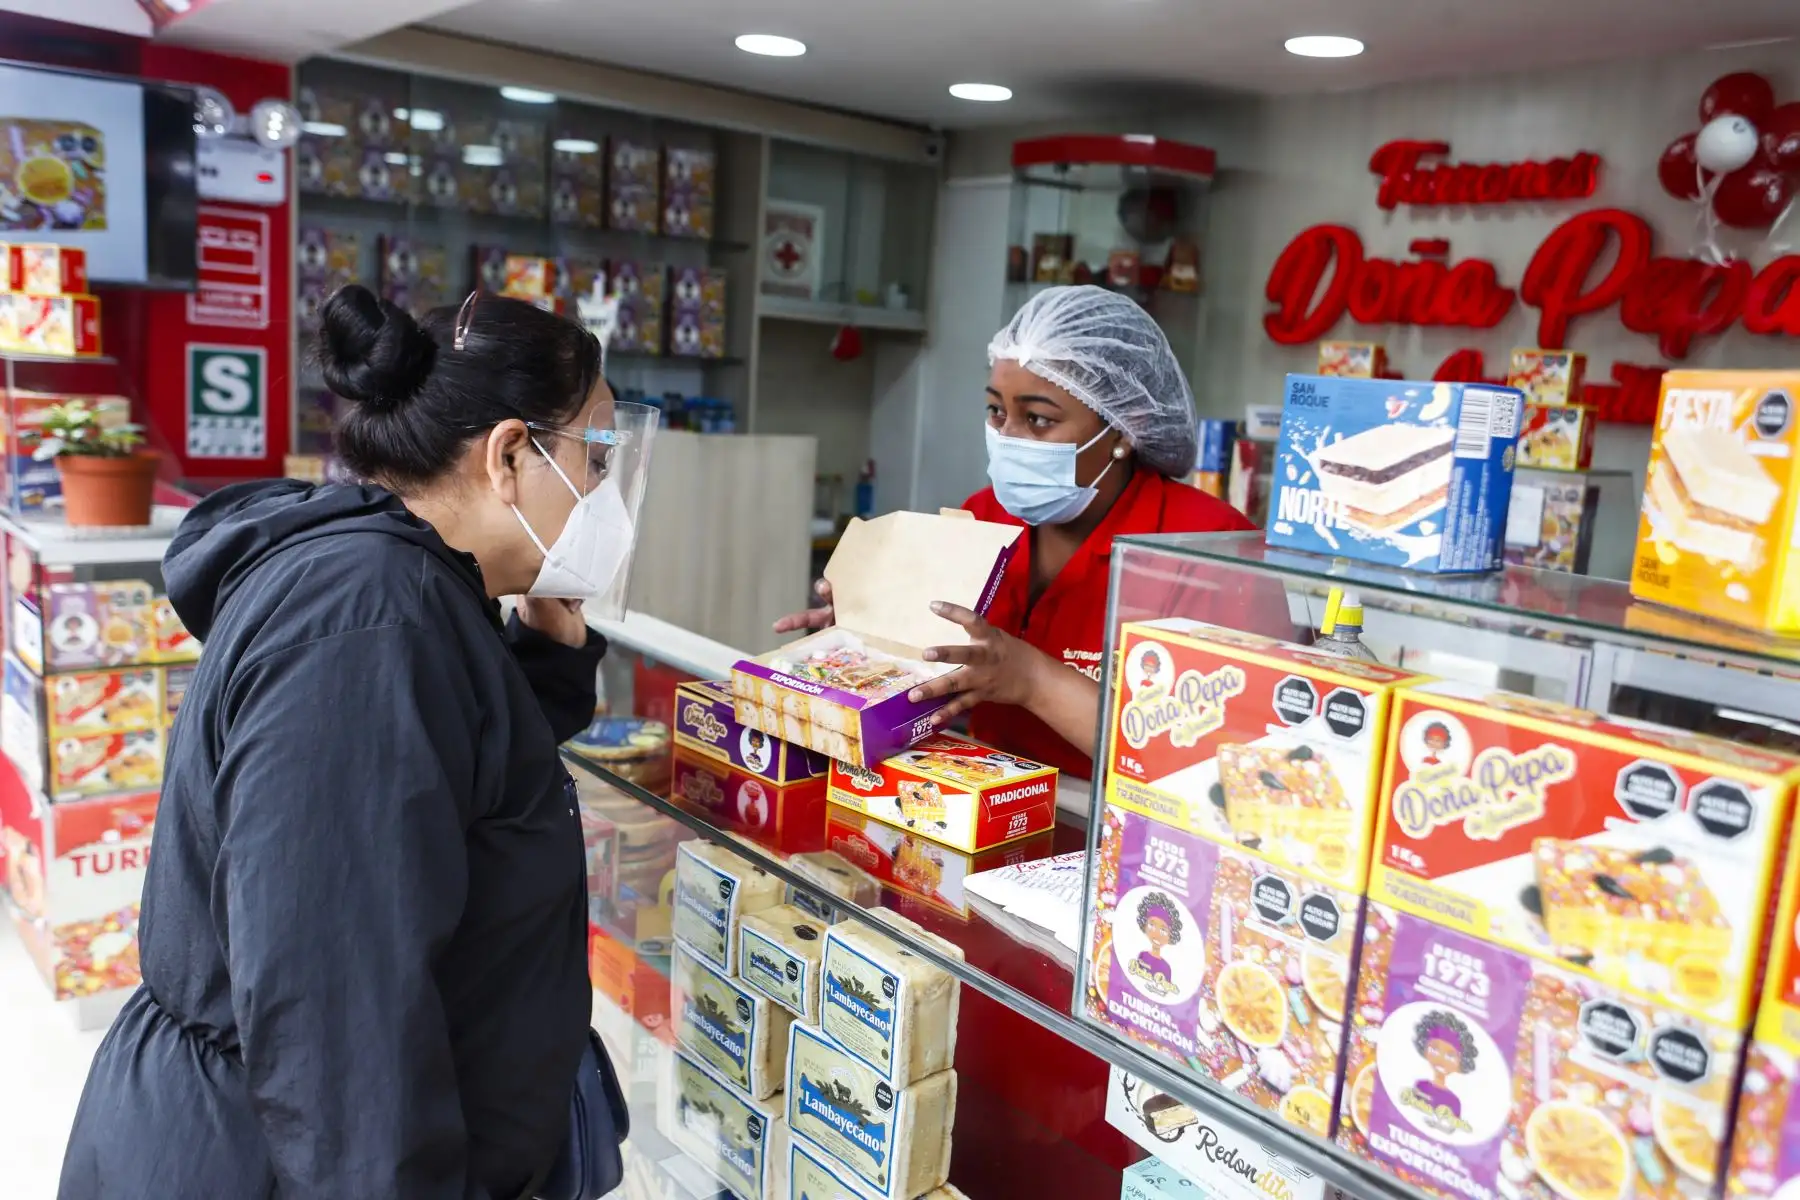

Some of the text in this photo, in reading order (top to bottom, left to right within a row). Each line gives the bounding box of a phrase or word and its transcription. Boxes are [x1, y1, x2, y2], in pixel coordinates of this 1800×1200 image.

[1369, 139, 1602, 210] Turrones
[1264, 207, 1800, 360] Doña Pepa
[201, 355, 253, 414] S
[1290, 393, 1331, 408] ROQUE
[1291, 382, 1316, 394] SAN
[1637, 570, 1672, 589] ROQUE
[1639, 556, 1660, 571] SAN
[769, 672, 825, 695] EXPORTACIÓN
[1126, 704, 1180, 743] Doña
[1180, 671, 1239, 715] Pepa
[912, 722, 933, 737] 1973
[860, 767, 884, 785] Pepa
[989, 781, 1050, 807] TRADICIONAL
[1399, 786, 1478, 832] Doña
[1480, 751, 1565, 800] Pepa
[1009, 817, 1029, 831] 1973
[1011, 812, 1027, 820] DESDE
[1144, 844, 1190, 879] 1973
[1150, 835, 1186, 858] DESDE
[680, 890, 722, 928] Lambayecano
[1423, 952, 1491, 998] 1973
[830, 984, 887, 1031] Lambayecano
[684, 1002, 742, 1057] Lambayecano
[1108, 999, 1194, 1053] EXPORTACIÓN
[805, 1091, 880, 1152] Lambayecano
[1195, 1125, 1293, 1200] Redondito
